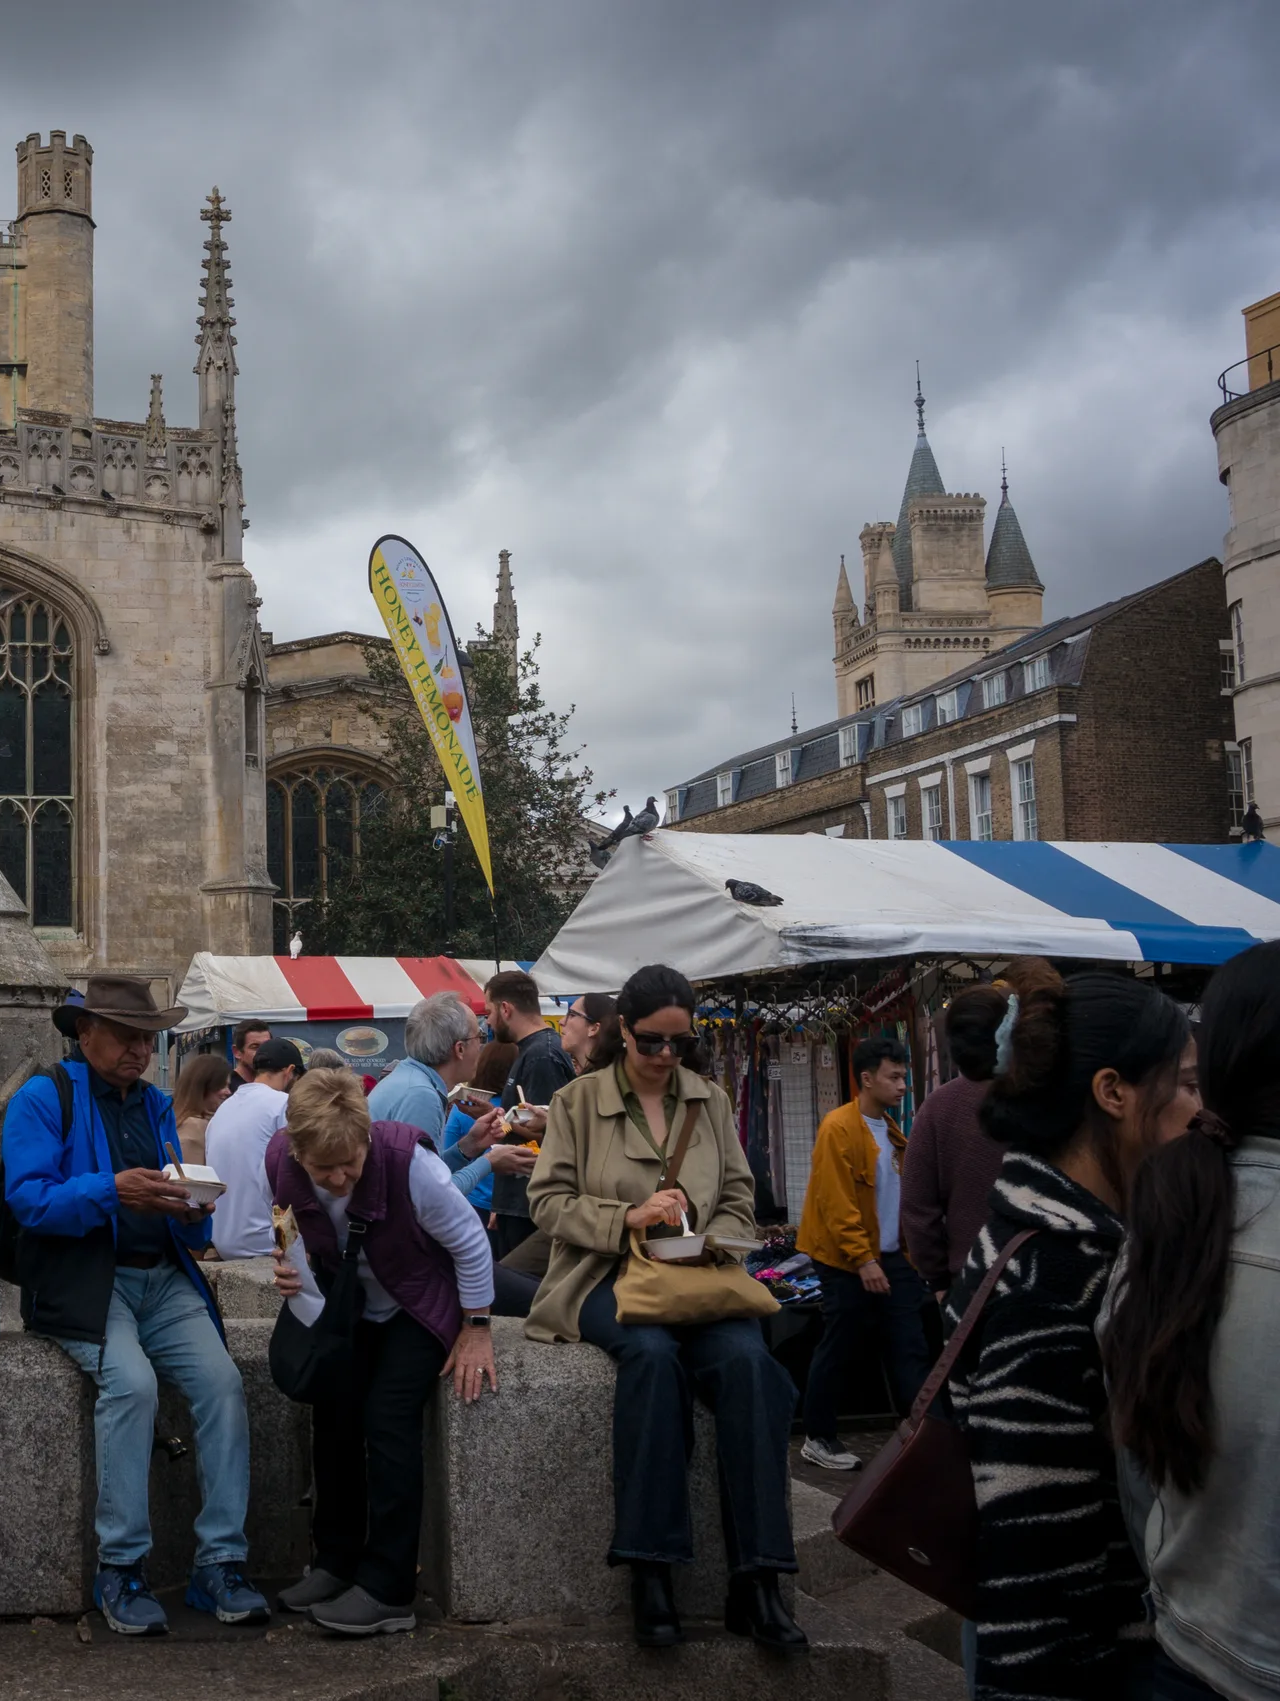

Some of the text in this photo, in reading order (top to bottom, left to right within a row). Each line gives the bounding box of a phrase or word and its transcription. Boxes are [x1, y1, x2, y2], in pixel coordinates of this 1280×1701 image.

[374, 564, 420, 652] HONEY
[415, 661, 479, 802] LEMONADE
[387, 617, 413, 675] GELATO
[418, 692, 445, 748] SORBET
